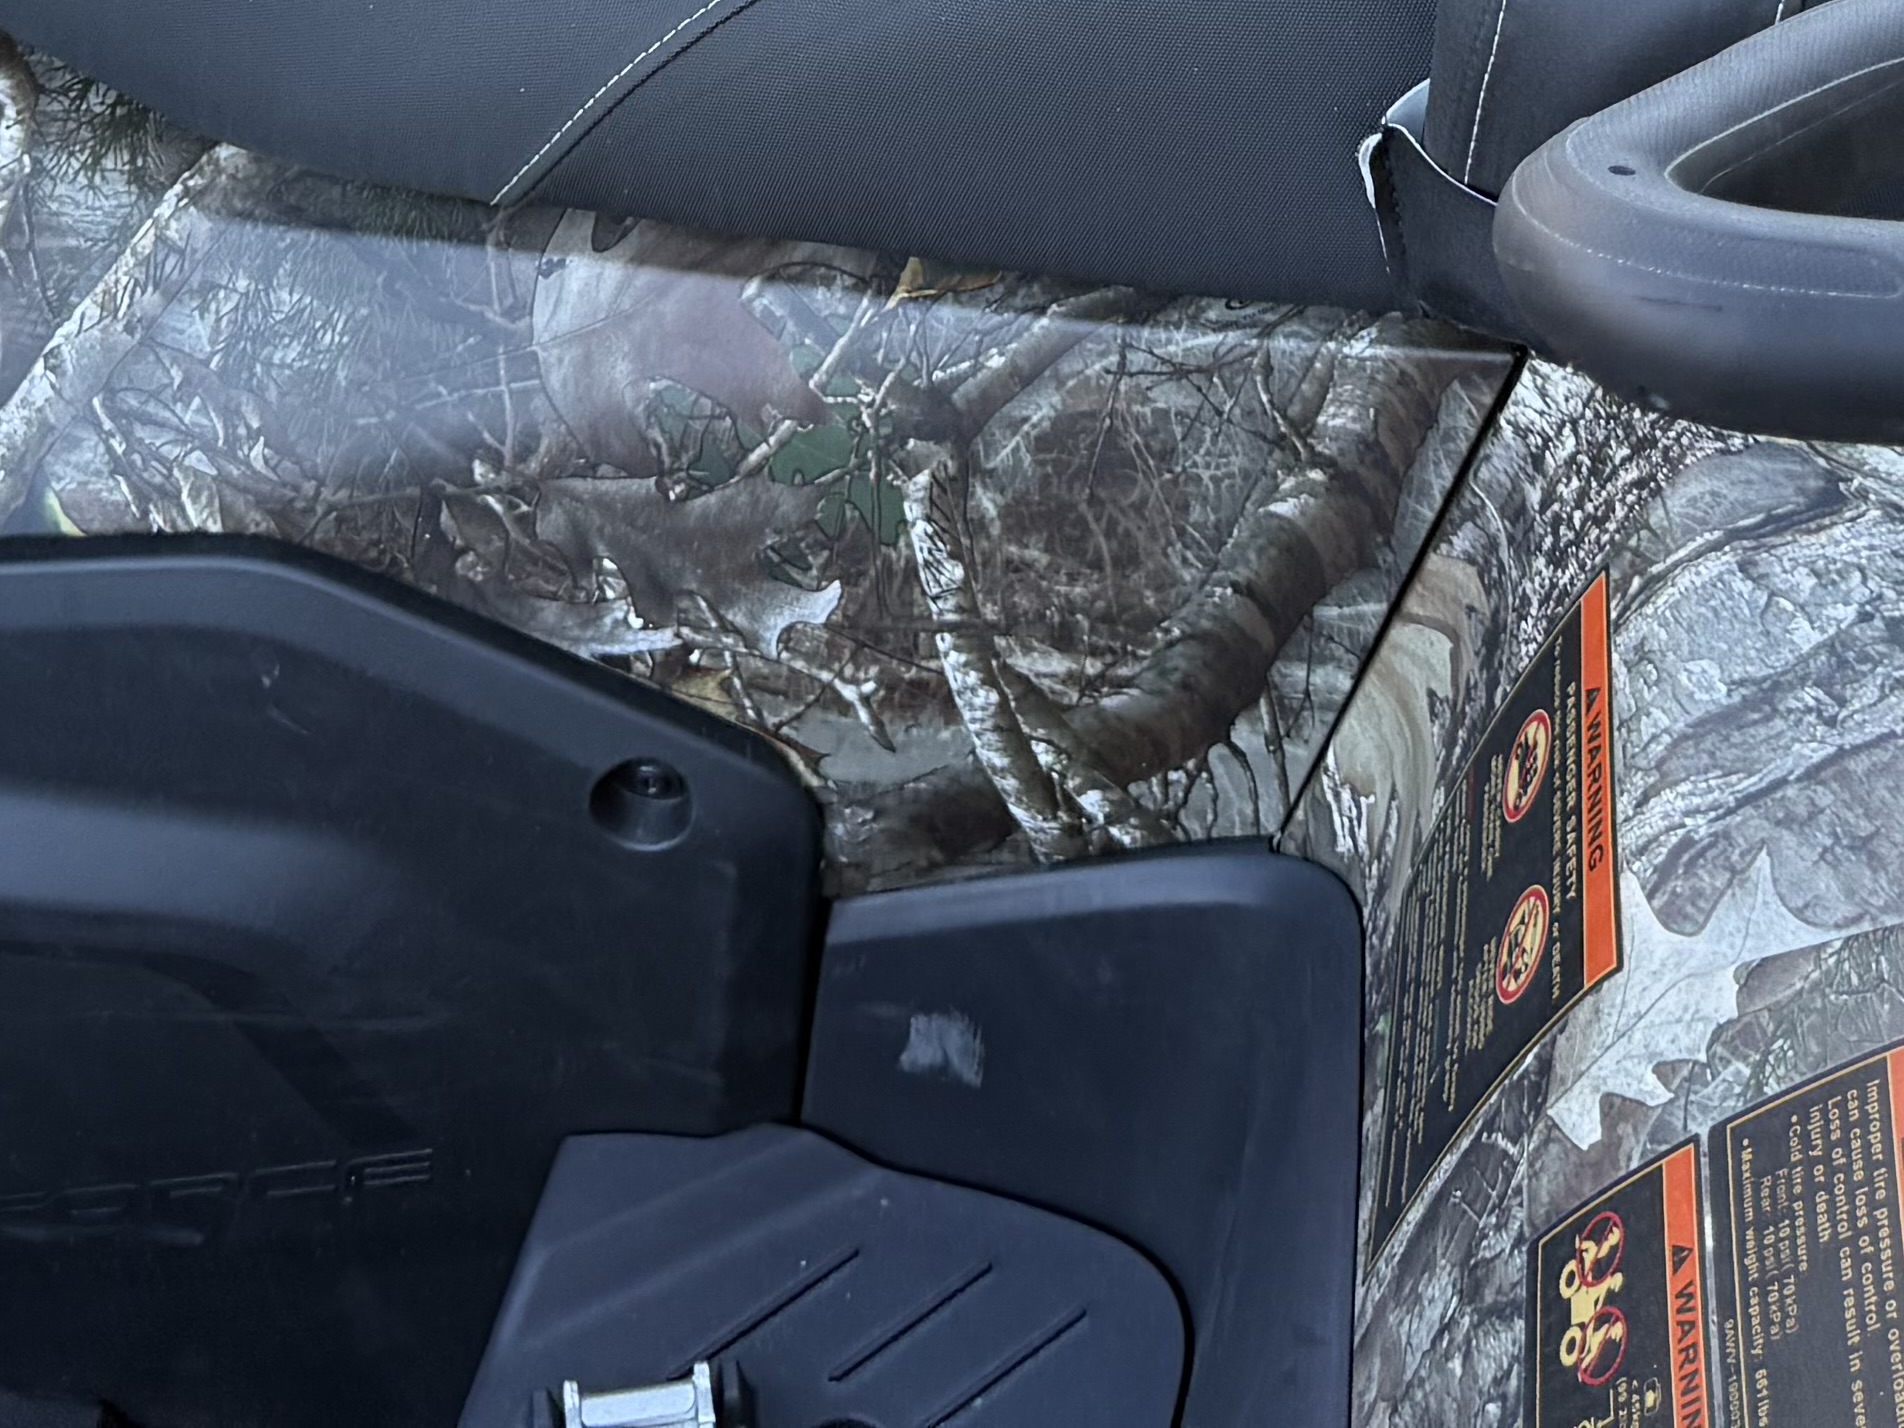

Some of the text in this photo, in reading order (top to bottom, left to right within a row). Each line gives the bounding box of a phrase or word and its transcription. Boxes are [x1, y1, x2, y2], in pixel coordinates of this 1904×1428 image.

[1565, 681, 1578, 900] PASSENGER SAFETY
[1586, 715, 1604, 872] WARNING
[1552, 792, 1562, 853] SEVERE
[1552, 858, 1562, 914] INJURY
[1808, 1105, 1826, 1157] injury
[1845, 1089, 1862, 1121] can
[1863, 1080, 1884, 1162] Improper
[1791, 1166, 1807, 1195] tire
[1812, 1165, 1827, 1182] or
[1849, 1128, 1867, 1181] cause
[1739, 1146, 1756, 1221] Maximum
[1853, 1187, 1872, 1228] loss
[1872, 1168, 1890, 1200] tire
[1743, 1227, 1761, 1281] weight
[1826, 1096, 1869, 1428] Loss of control can result in seve
[1859, 1236, 1874, 1257] of
[1872, 1208, 1896, 1292] pressure
[1885, 1300, 1900, 1320] or
